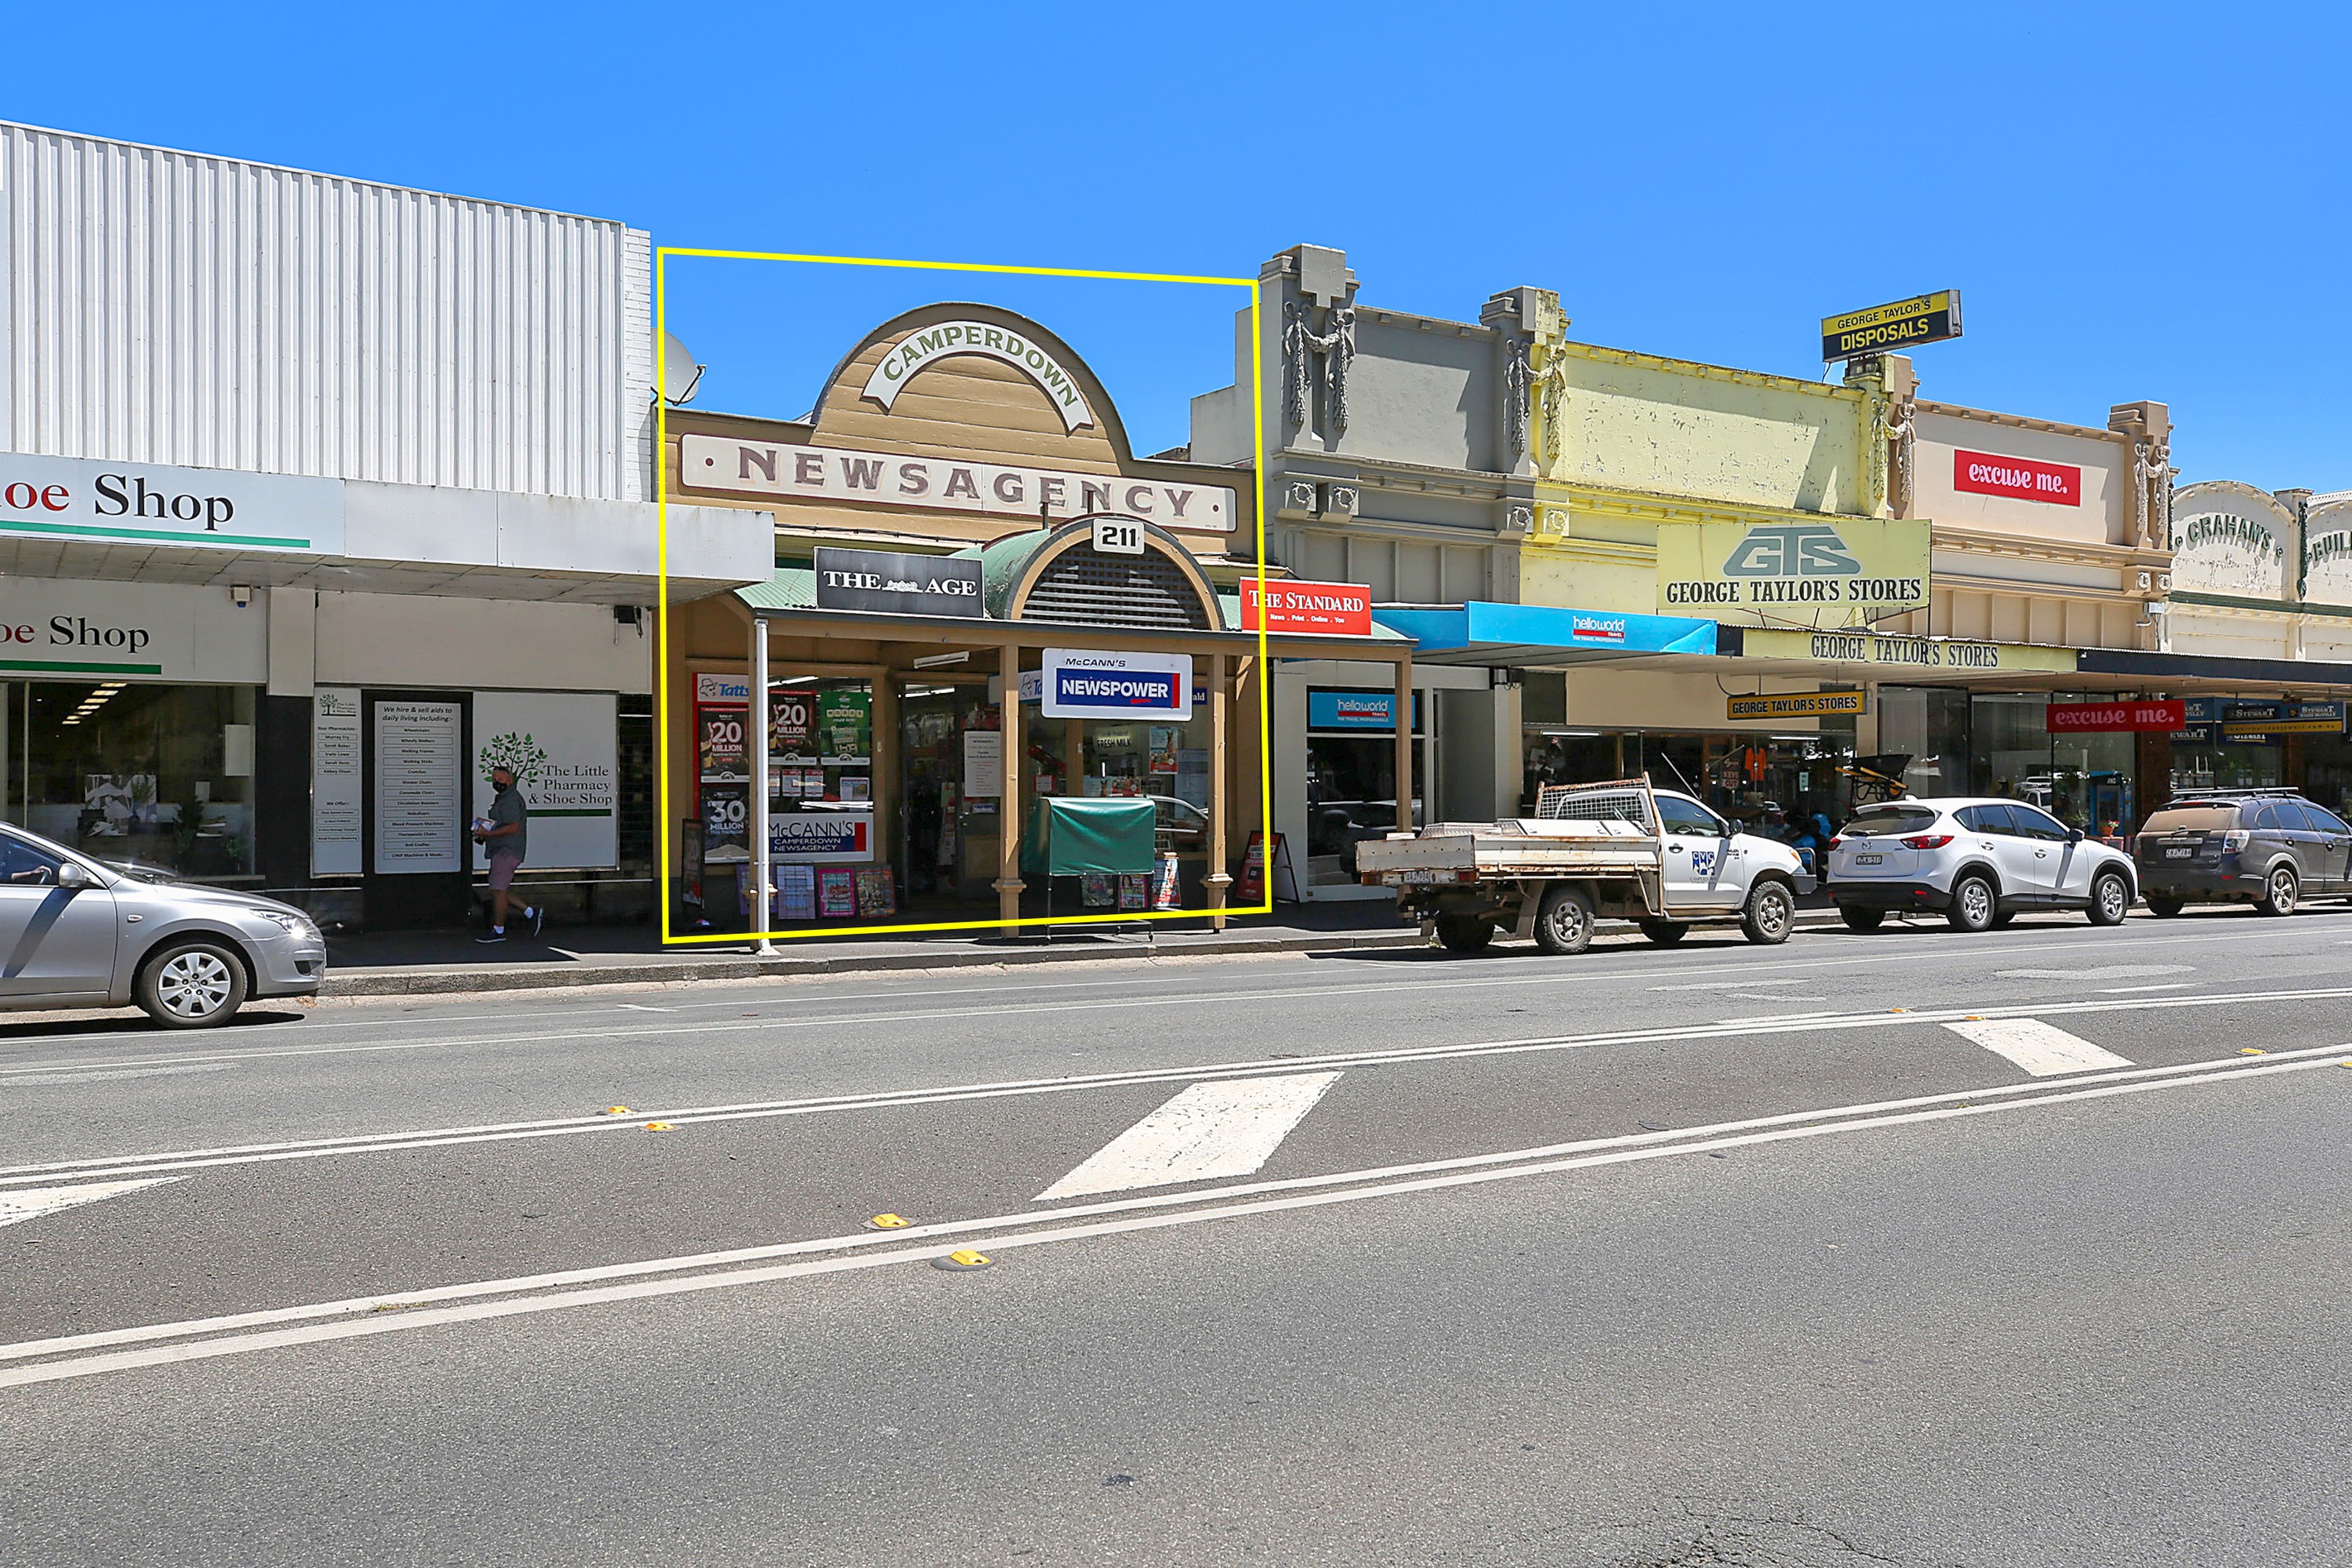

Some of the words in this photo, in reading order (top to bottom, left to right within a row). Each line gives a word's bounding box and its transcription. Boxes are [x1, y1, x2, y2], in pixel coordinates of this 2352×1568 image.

[1837, 312, 1879, 329] GEORGE
[1883, 300, 1931, 319] TAYLOR'S
[1840, 318, 1929, 352] DISPOSALS
[883, 325, 1080, 408] CAMPERDOWN
[738, 446, 1194, 519] NEWSAGENCY
[1968, 463, 2032, 488] excuse
[2036, 473, 2068, 494] me.
[0, 482, 70, 512] oe
[94, 473, 234, 531] Shop
[1101, 526, 1138, 548] 211
[2187, 514, 2273, 551] GRAHAM'S
[1722, 526, 1862, 576] GTS
[2312, 531, 2352, 562] BUIL
[823, 570, 882, 590] THE
[925, 578, 978, 597] AGE
[1666, 581, 1739, 604] GEORGE
[1750, 580, 1840, 603] TAYLOR'S
[1848, 579, 1922, 602] STORES
[1286, 591, 1364, 613] STANDARD
[49, 615, 150, 654] Shop
[1811, 635, 1866, 660] GEORGE
[1874, 638, 1941, 666] TAYLOR'S
[1948, 644, 1998, 667] STORES
[1065, 658, 1126, 667] McCANN'S
[1061, 679, 1168, 698] NEWSPOWER
[1337, 699, 1388, 711] helloworld
[1732, 700, 1768, 714] GEORGE
[1771, 698, 1815, 713] TAYLOR'S
[1818, 695, 1858, 711] STORES
[2055, 709, 2126, 726] excuse
[2135, 706, 2175, 724] me.
[1097, 738, 1115, 748] FRESH
[543, 765, 570, 777] The
[574, 765, 608, 777] Little
[543, 779, 611, 792] Pharmacy
[529, 793, 538, 804] &
[543, 792, 575, 804] Shoe
[580, 792, 613, 806] Shop
[710, 822, 744, 830] MILLION
[768, 820, 854, 837] McCANN'S
[1692, 852, 1715, 861] CVC
